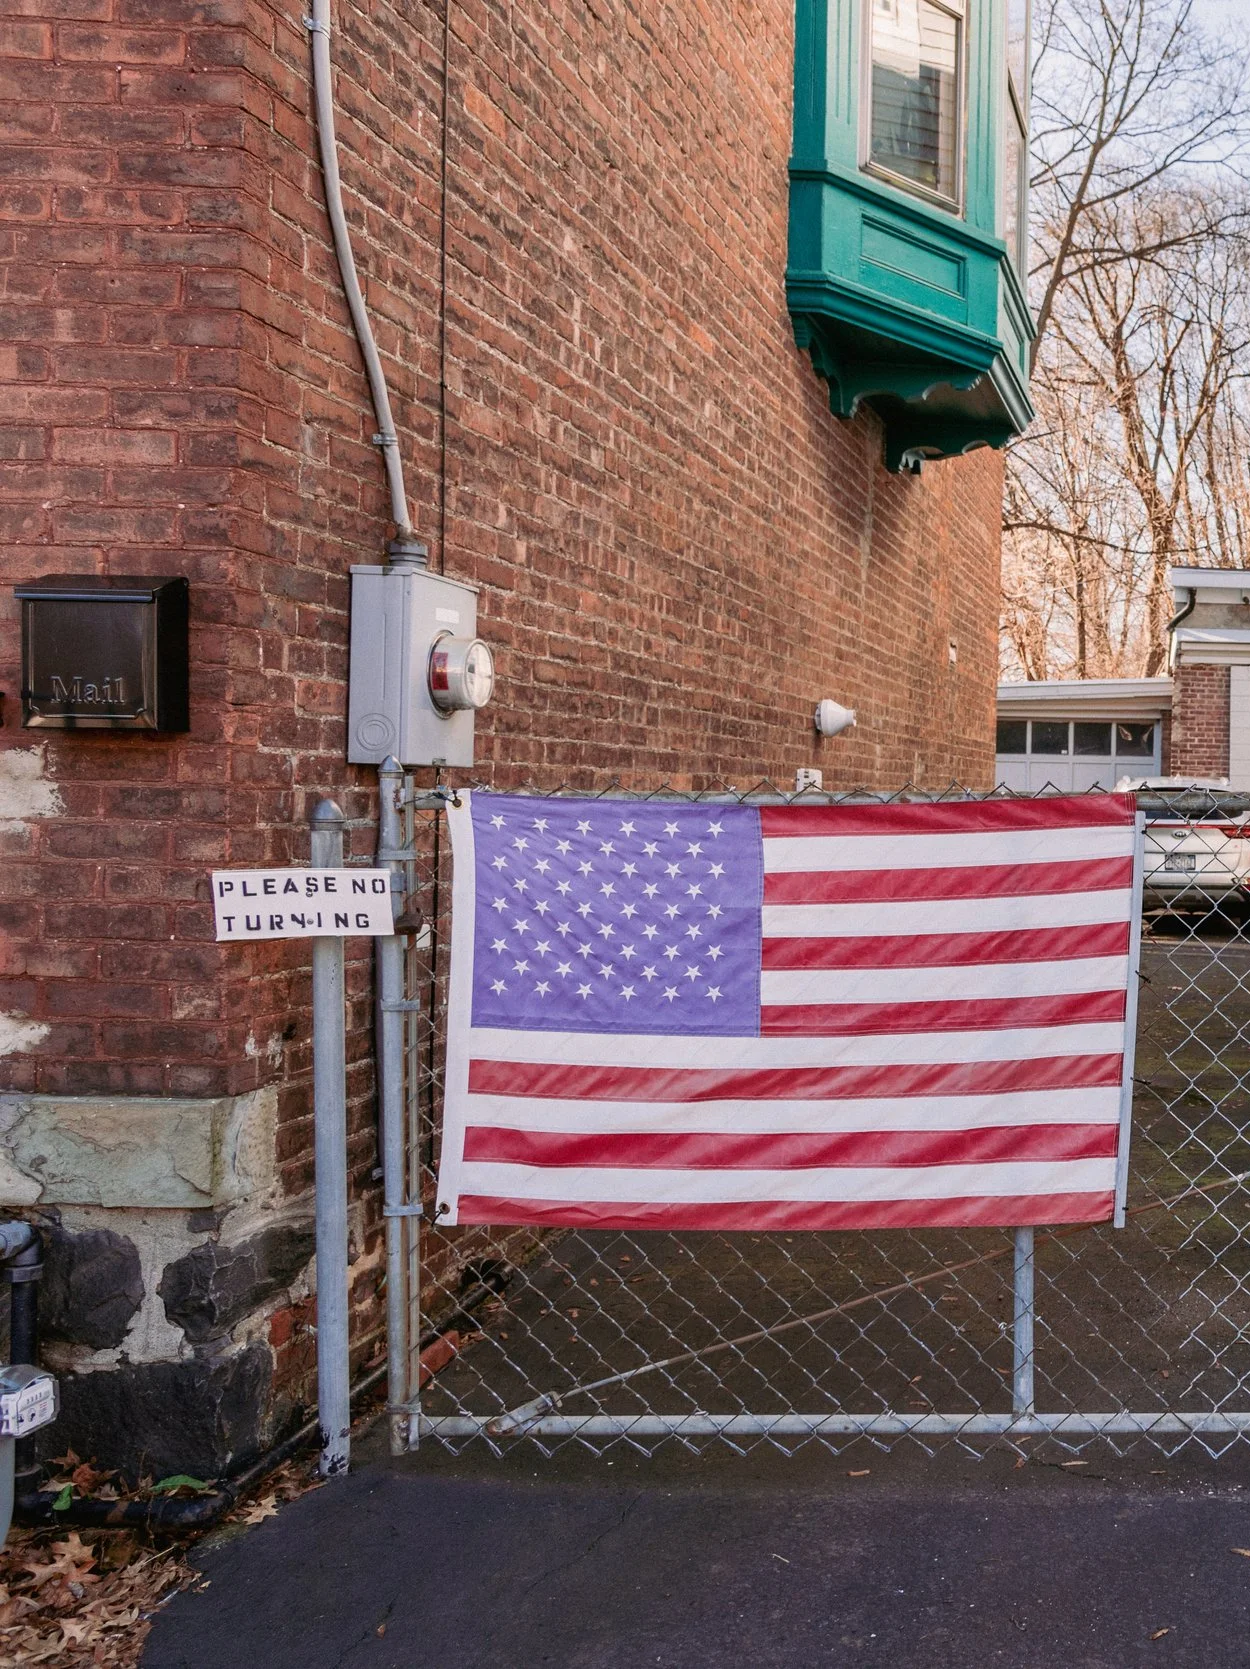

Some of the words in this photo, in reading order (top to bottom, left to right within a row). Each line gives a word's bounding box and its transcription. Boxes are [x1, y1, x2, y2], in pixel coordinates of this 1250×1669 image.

[50, 675, 127, 704] Mail
[219, 877, 337, 898] PLEASE
[352, 878, 386, 895] NO
[223, 911, 370, 932] TURNING
